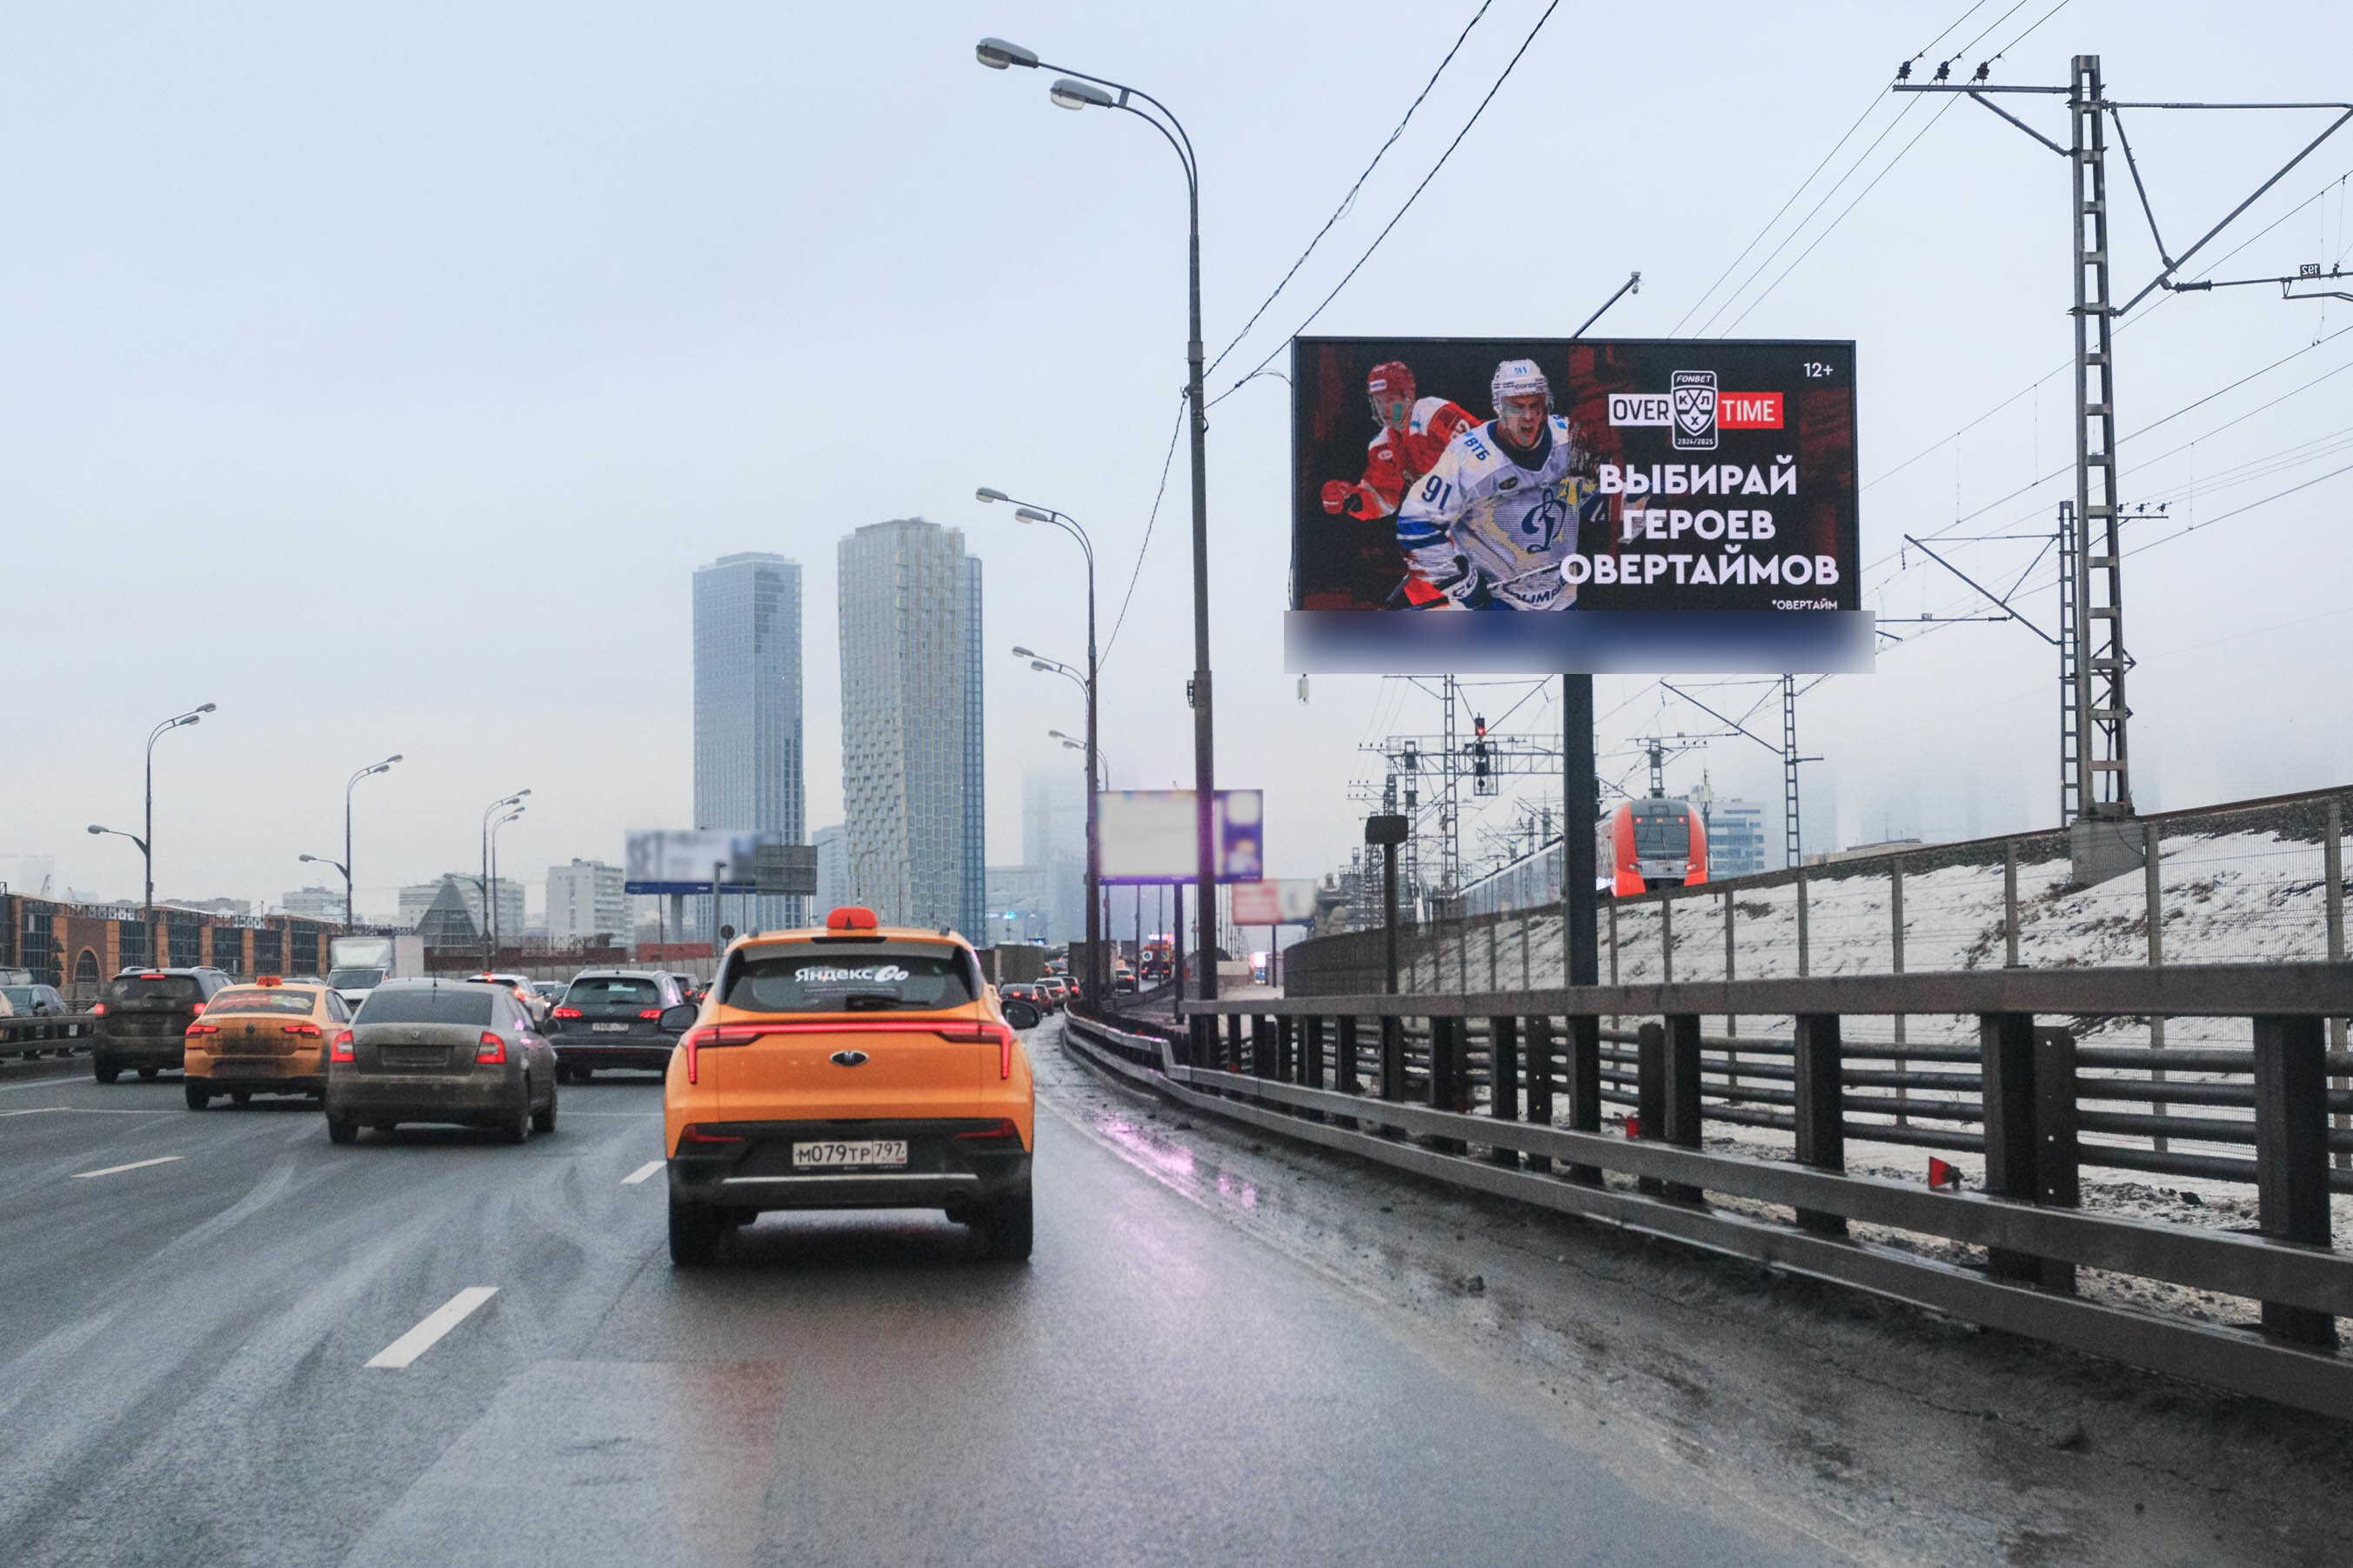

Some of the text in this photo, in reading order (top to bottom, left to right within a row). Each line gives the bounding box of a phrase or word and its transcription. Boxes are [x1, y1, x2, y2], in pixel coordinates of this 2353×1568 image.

[1676, 375, 1713, 384] FONBET
[1803, 362, 1834, 377] 12+
[1613, 399, 1775, 422] OVER TIME
[1464, 437, 1490, 461] ВТБ
[1600, 454, 1797, 495] ВЫБИРАЙ
[1421, 475, 1453, 510] 91
[1622, 510, 1776, 540] ГЕРОЕВ
[1560, 544, 1840, 585] ОВЕРТАЙМОВ
[794, 964, 909, 982] Яндекс Go
[875, 1143, 902, 1157] 797
